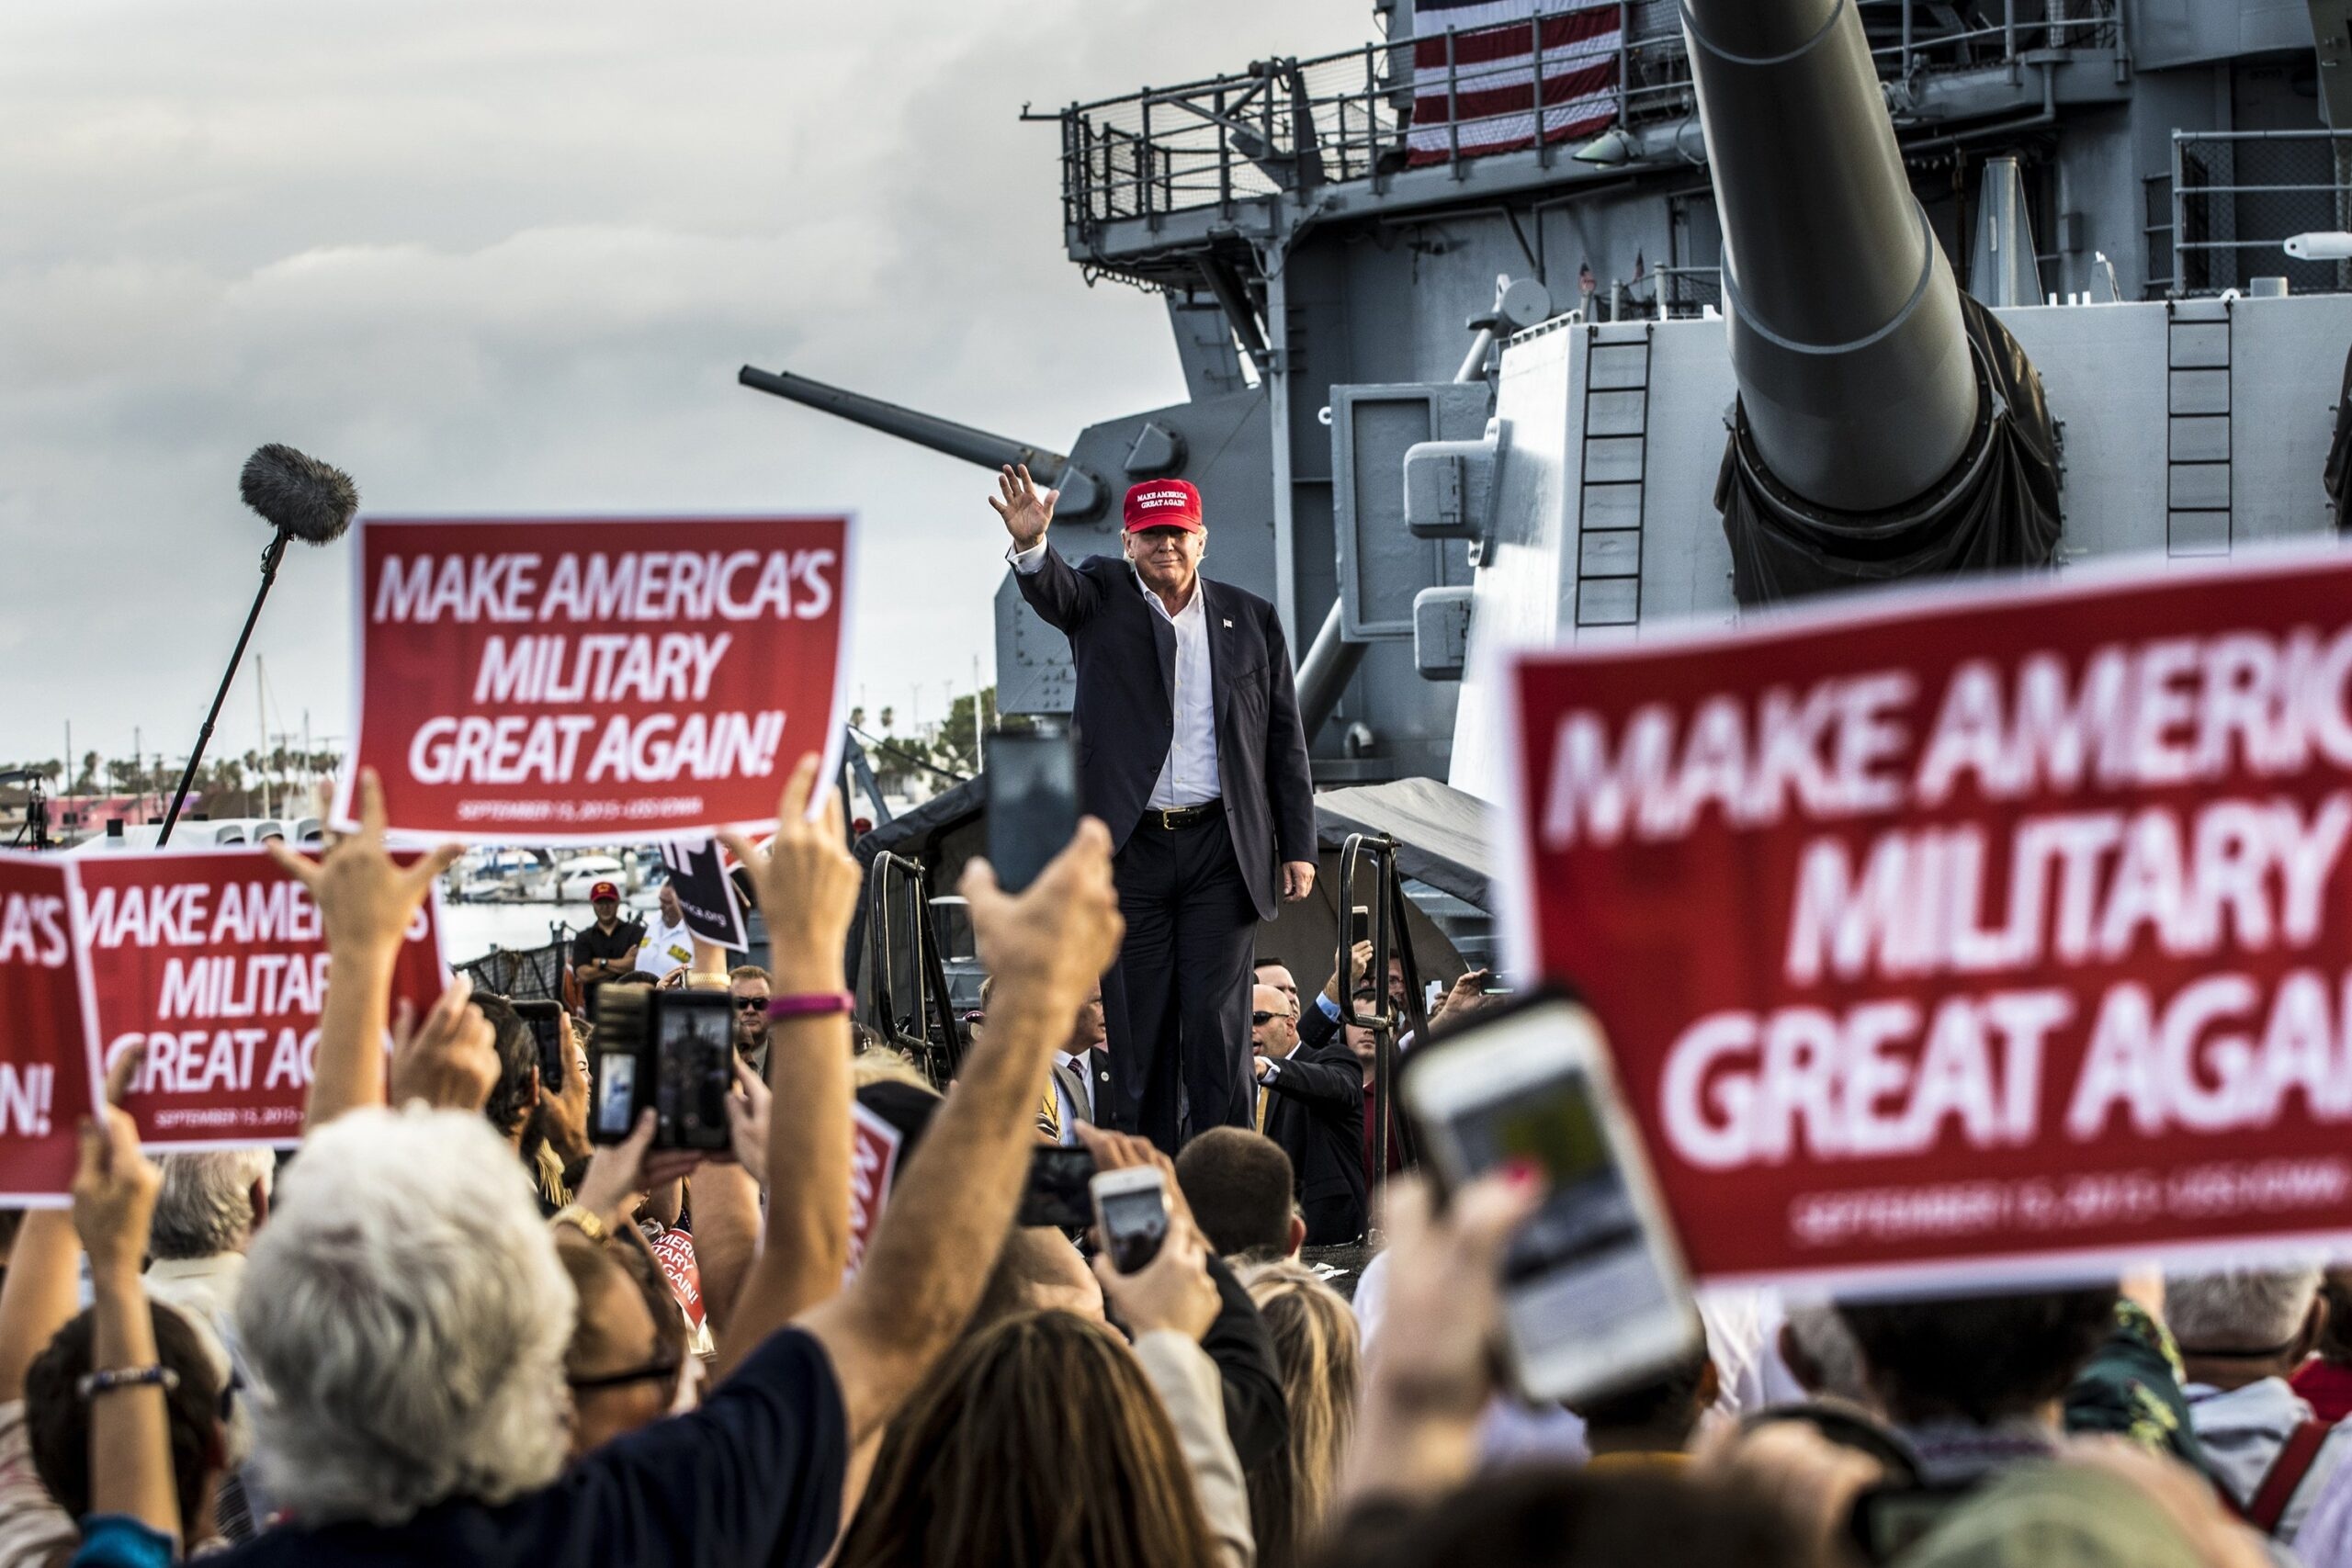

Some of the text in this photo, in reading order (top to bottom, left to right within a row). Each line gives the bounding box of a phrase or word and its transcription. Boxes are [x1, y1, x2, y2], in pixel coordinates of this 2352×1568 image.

[1136, 491, 1188, 502] MAKE AMERICA
[1141, 499, 1185, 509] GREAT AGAIN
[375, 550, 834, 623] MAKE AMERICA'S
[473, 632, 731, 704] MILITARY
[409, 709, 786, 784] GREAT AGAIN!
[1544, 671, 1917, 849] MAKE
[1785, 792, 2352, 985] MILITARY
[1662, 967, 2352, 1168] GREAT AGA
